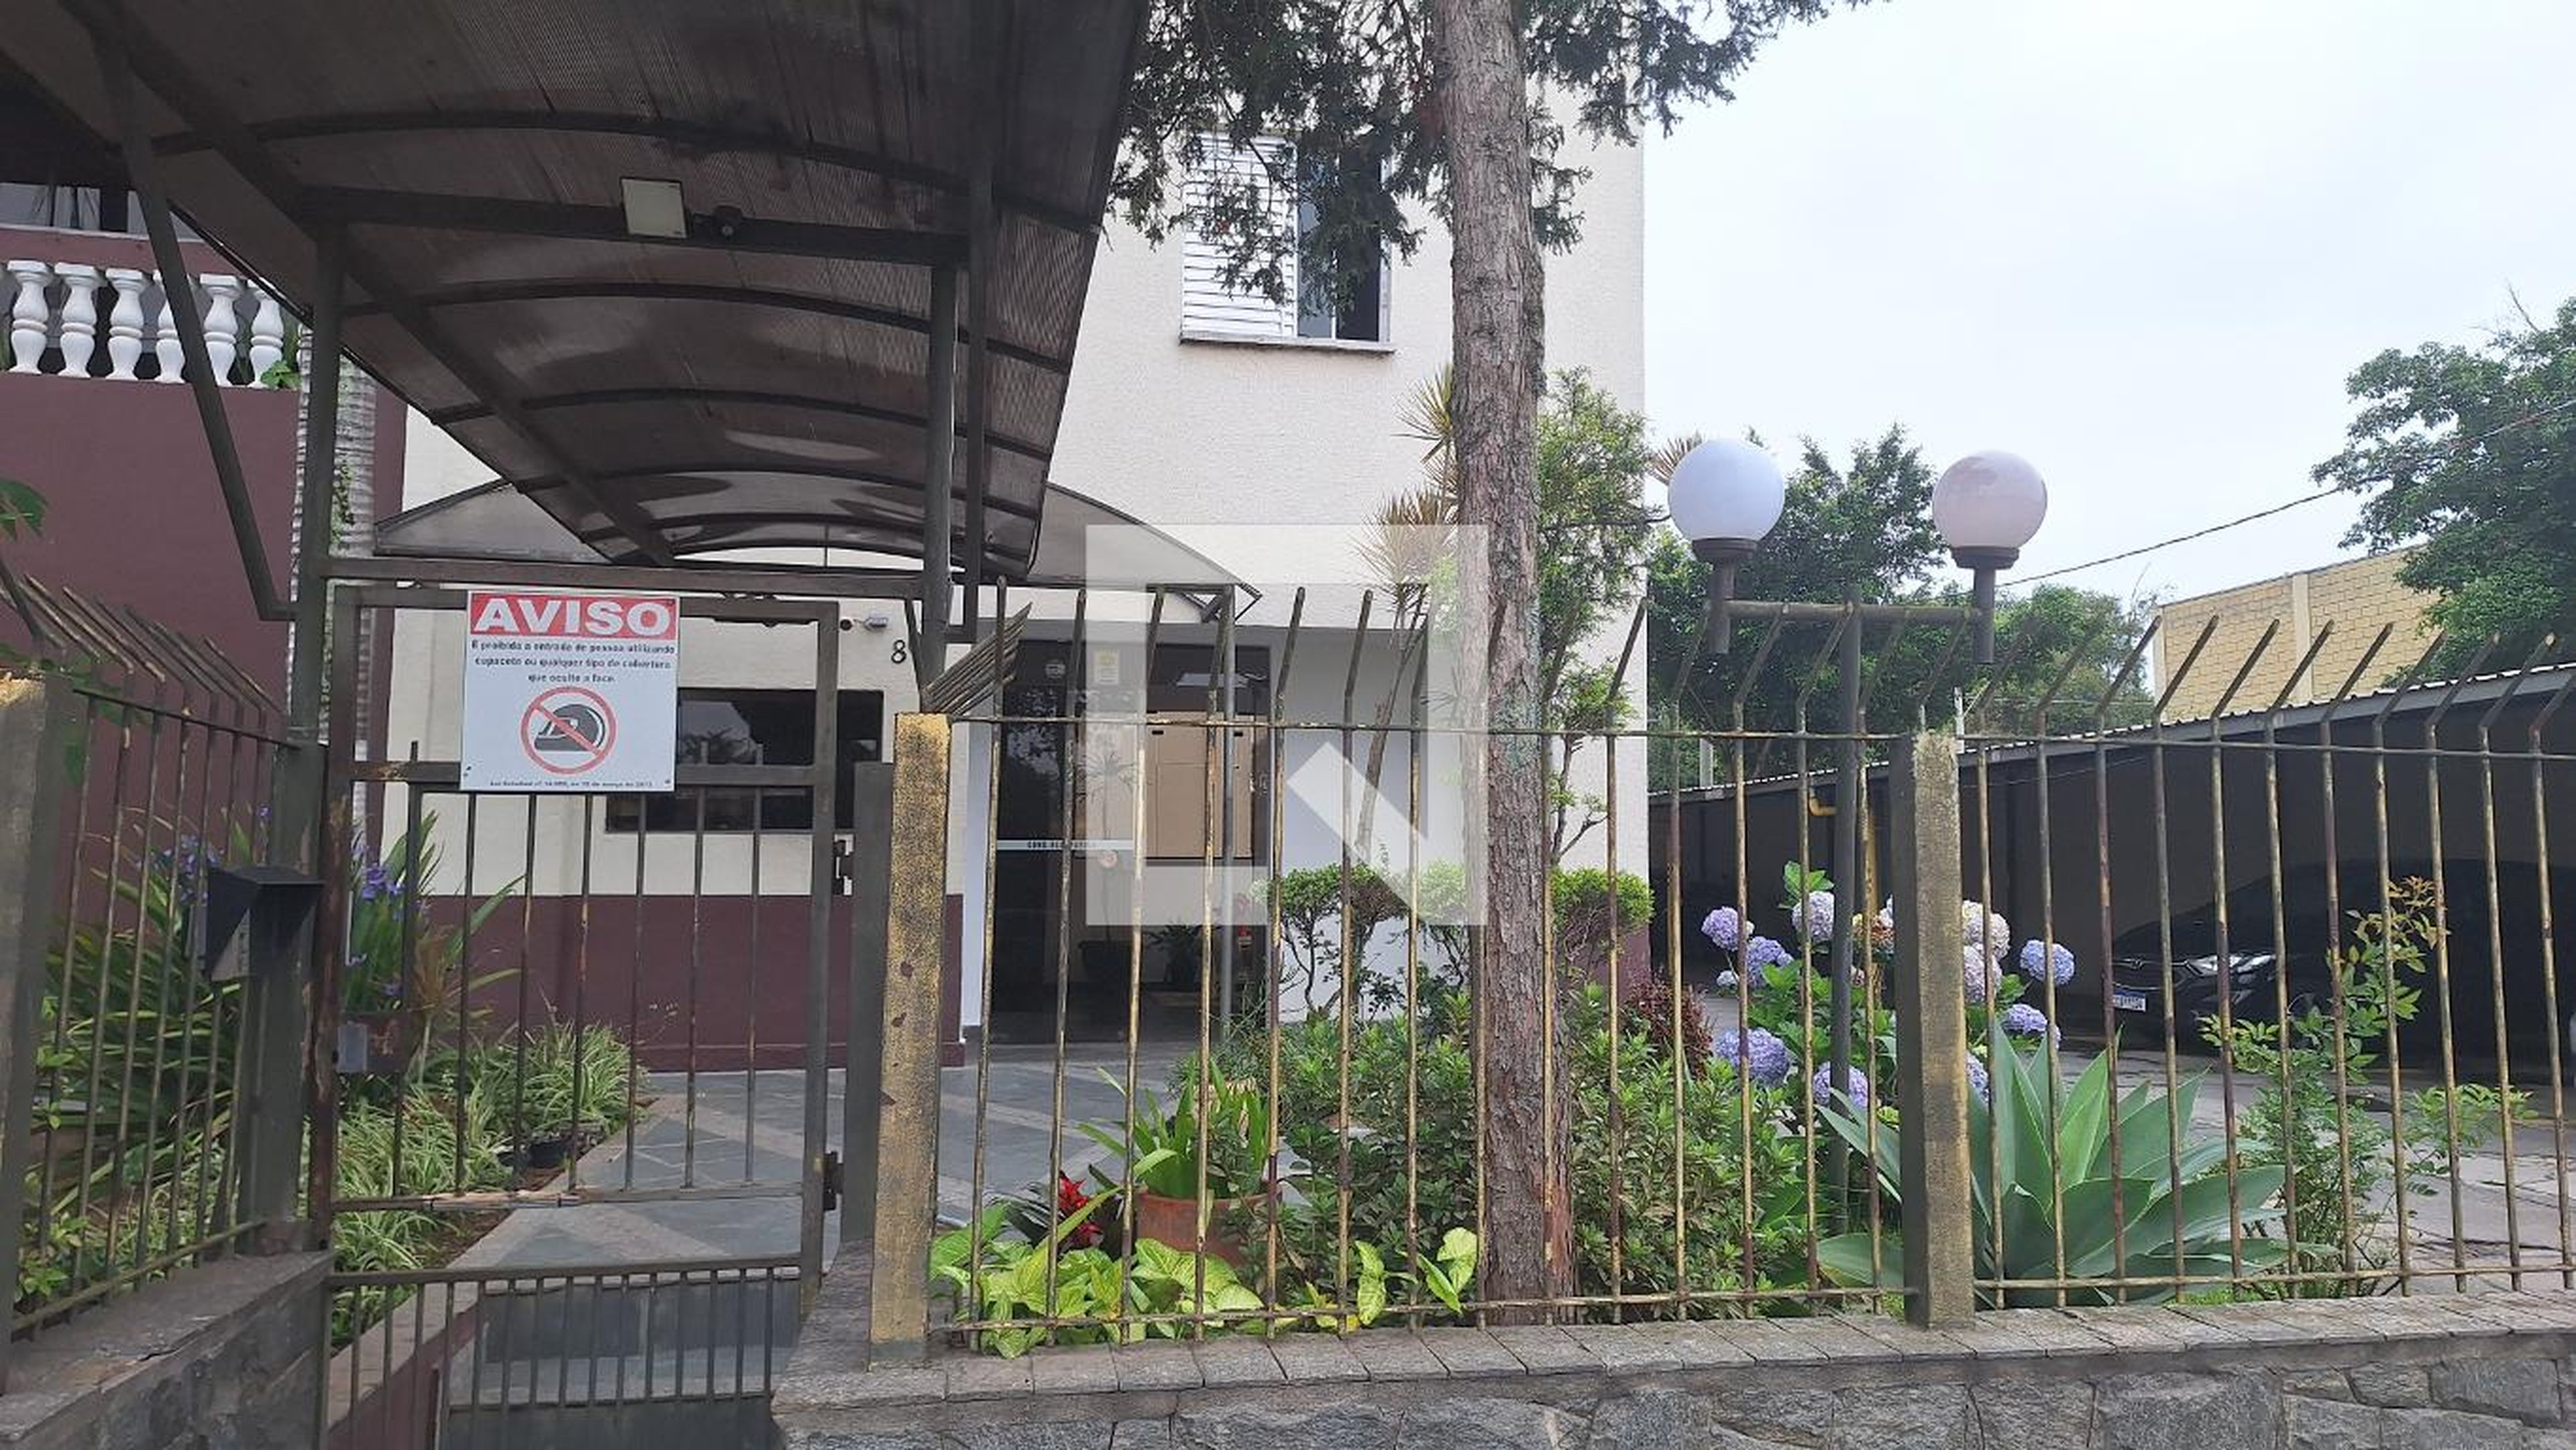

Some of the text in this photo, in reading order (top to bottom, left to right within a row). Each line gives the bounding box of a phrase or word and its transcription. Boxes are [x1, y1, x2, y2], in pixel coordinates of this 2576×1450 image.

[474, 598, 669, 636] AVISO
[534, 642, 572, 651] entrada
[575, 643, 588, 651] de
[608, 659, 620, 667] de
[528, 675, 547, 683] que
[549, 674, 581, 682] oculte
